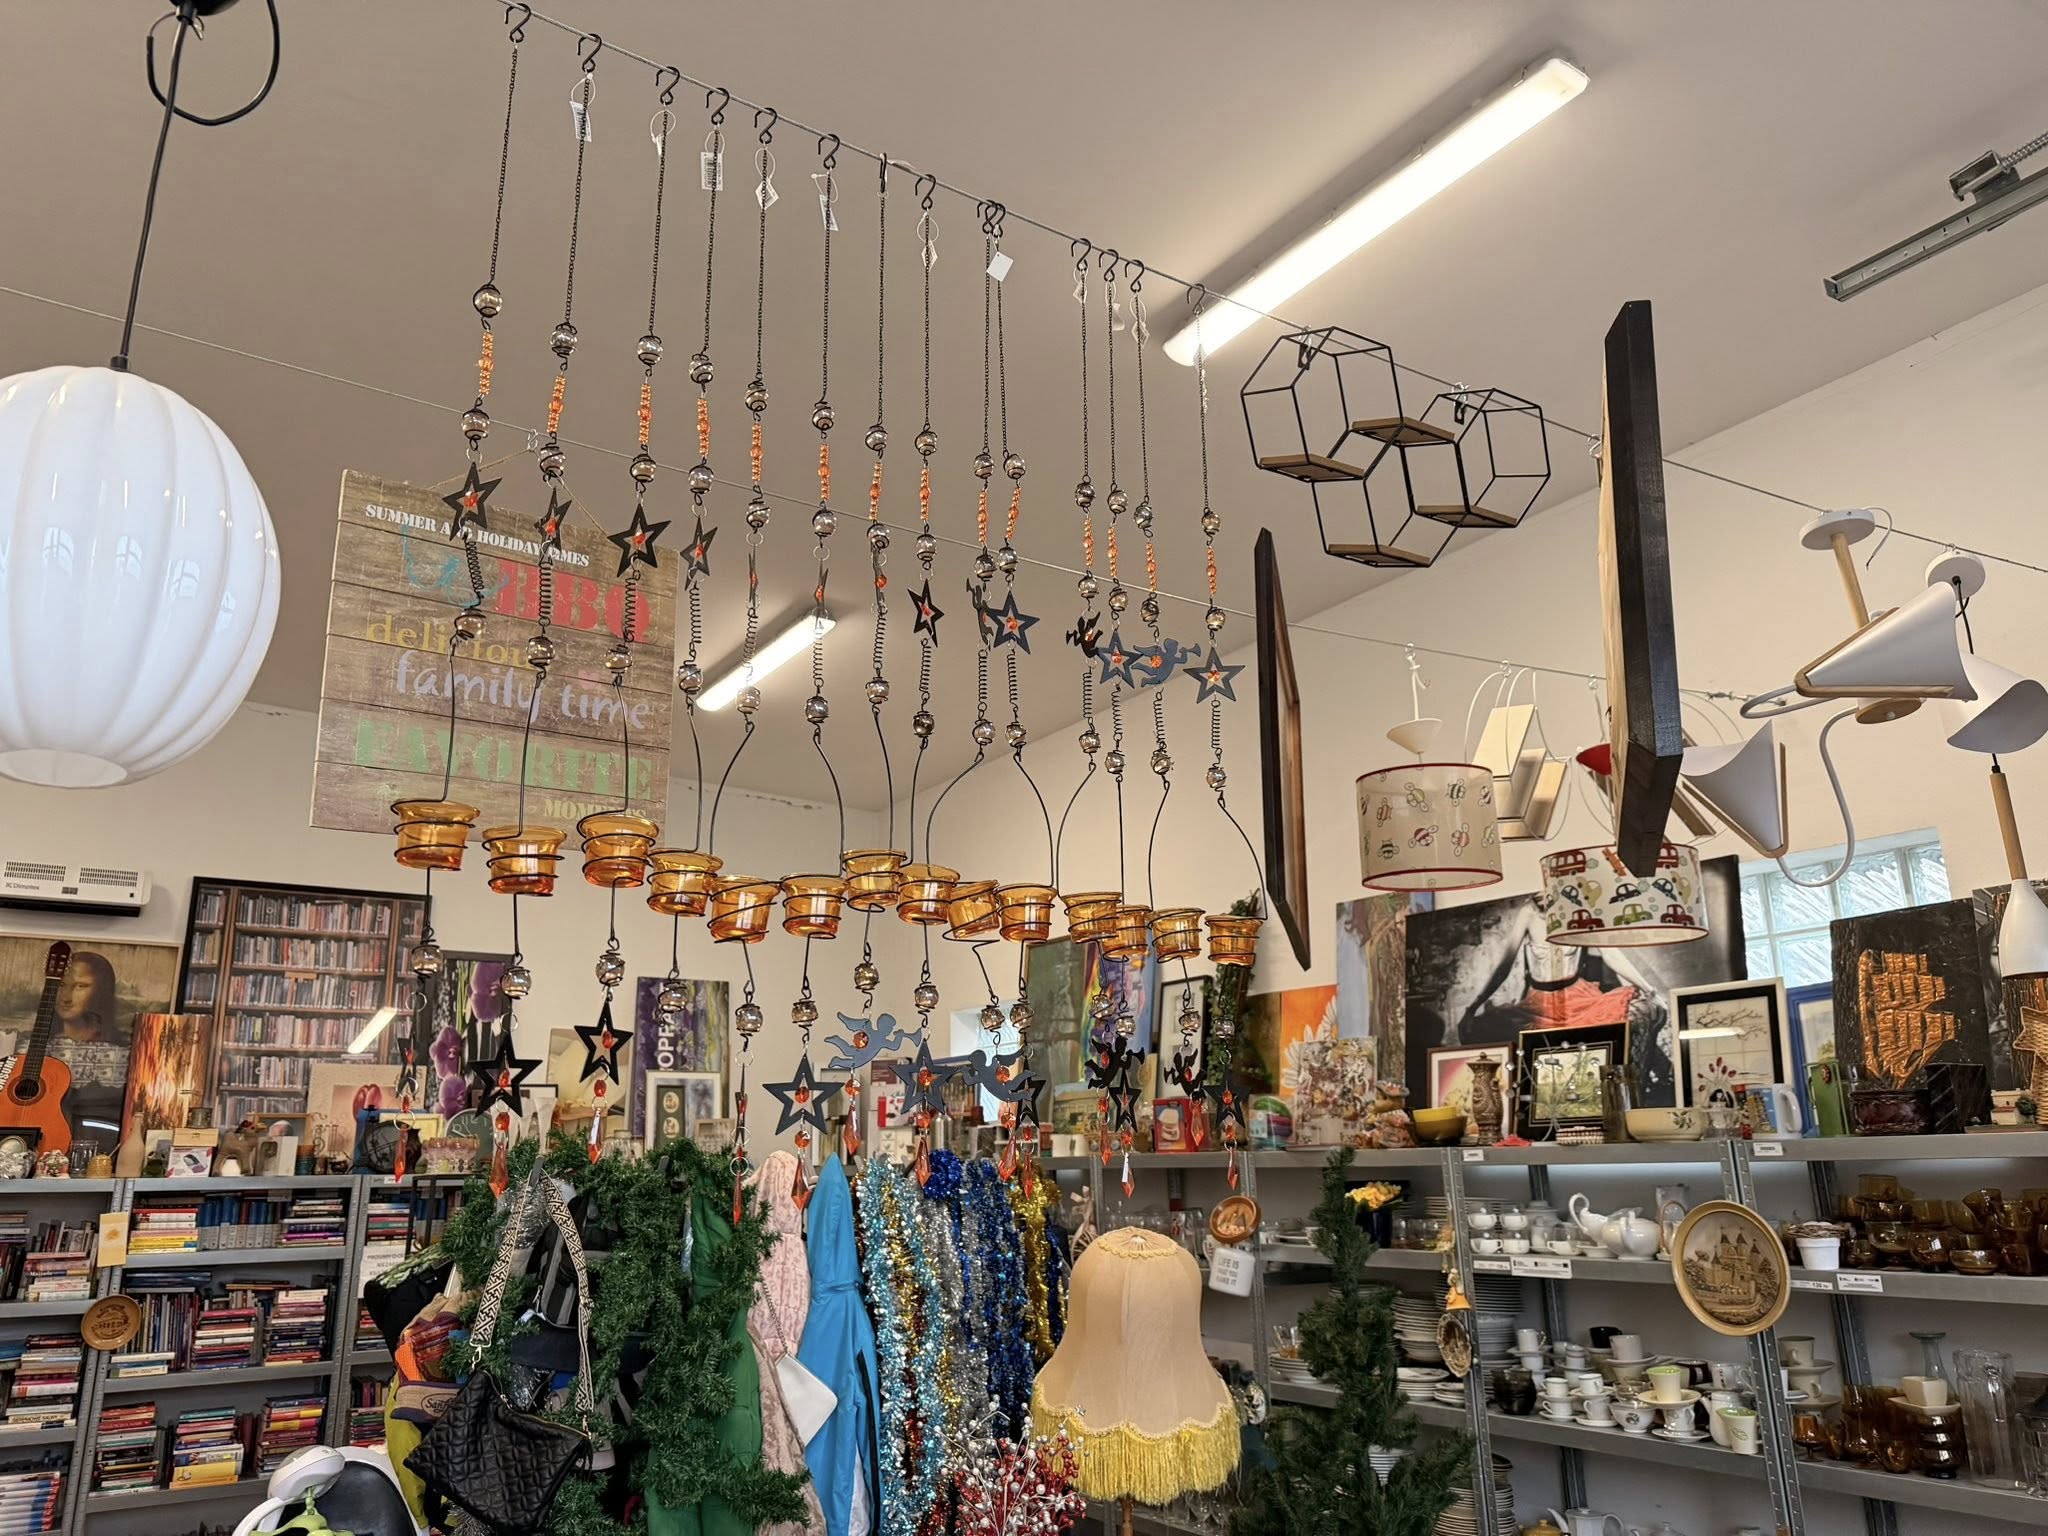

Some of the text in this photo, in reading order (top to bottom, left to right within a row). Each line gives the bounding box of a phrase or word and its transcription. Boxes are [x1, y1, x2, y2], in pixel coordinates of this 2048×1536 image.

[365, 504, 437, 533] SUMMER
[477, 531, 543, 556] HOLIDAY
[494, 558, 653, 644] BBQ
[394, 649, 650, 730] family time
[354, 717, 653, 801] FAVORITE
